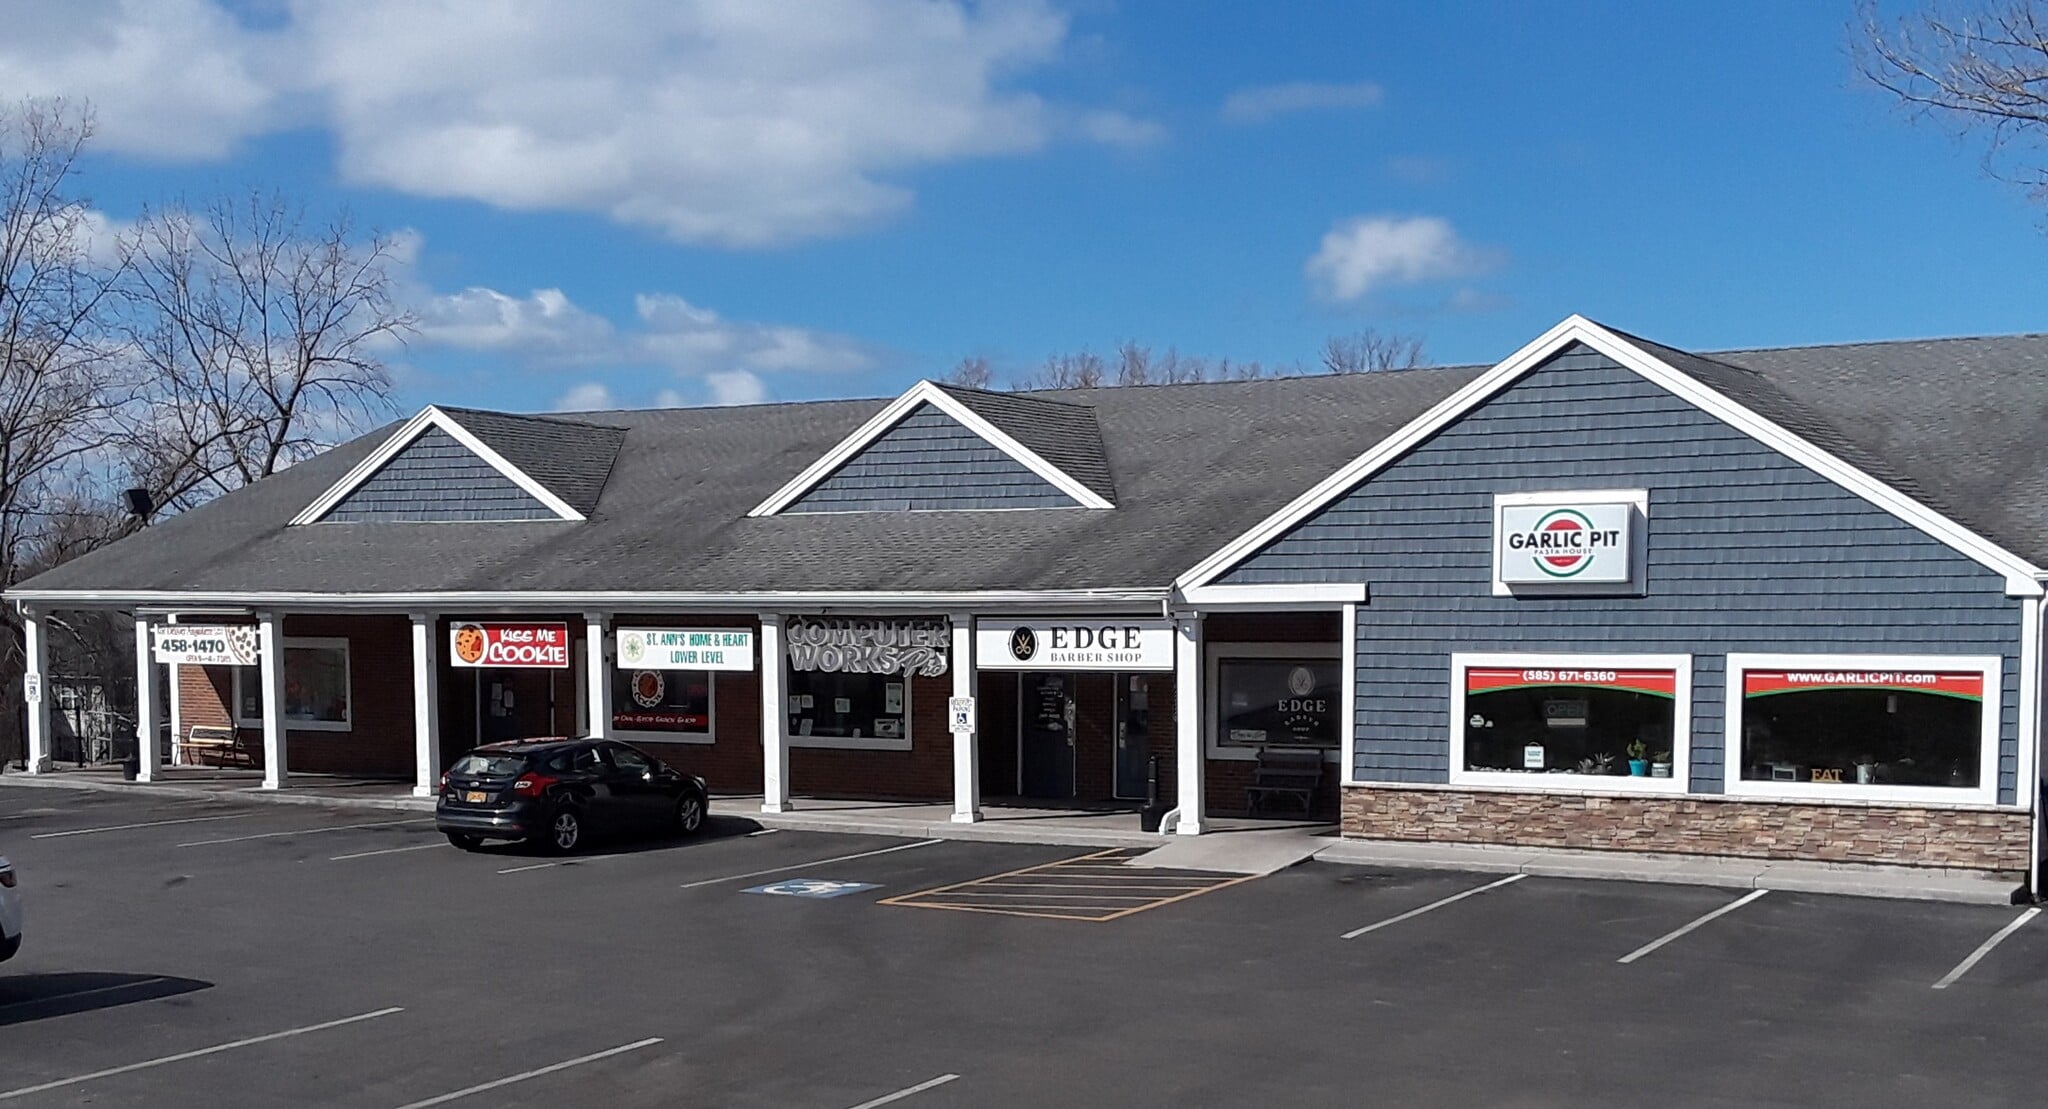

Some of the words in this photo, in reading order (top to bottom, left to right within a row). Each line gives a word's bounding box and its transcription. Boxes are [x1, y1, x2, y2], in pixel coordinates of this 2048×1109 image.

[1509, 532, 1582, 549] GARLIC
[1590, 531, 1620, 547] PIT
[787, 618, 950, 647] COMPUTER
[1050, 626, 1141, 649] EDGE
[646, 633, 659, 646] ST.
[660, 633, 685, 646] ANN'S
[689, 634, 712, 647] HOME
[714, 635, 720, 647] &
[722, 634, 748, 647] HEART
[489, 642, 565, 663] COOKIE
[670, 650, 698, 664] LOWER
[701, 651, 724, 664] LEVEL
[1050, 653, 1102, 662] BARBER
[1106, 653, 1142, 663] SHOP
[789, 645, 898, 674] WORKS
[896, 647, 948, 678] Pro
[1523, 671, 1555, 682] (585)
[1559, 671, 1616, 682] 671-6360
[1787, 673, 1936, 683] www.GARLICPIT.com
[1278, 699, 1326, 712] EDGE
[1811, 768, 1843, 782] EAT
